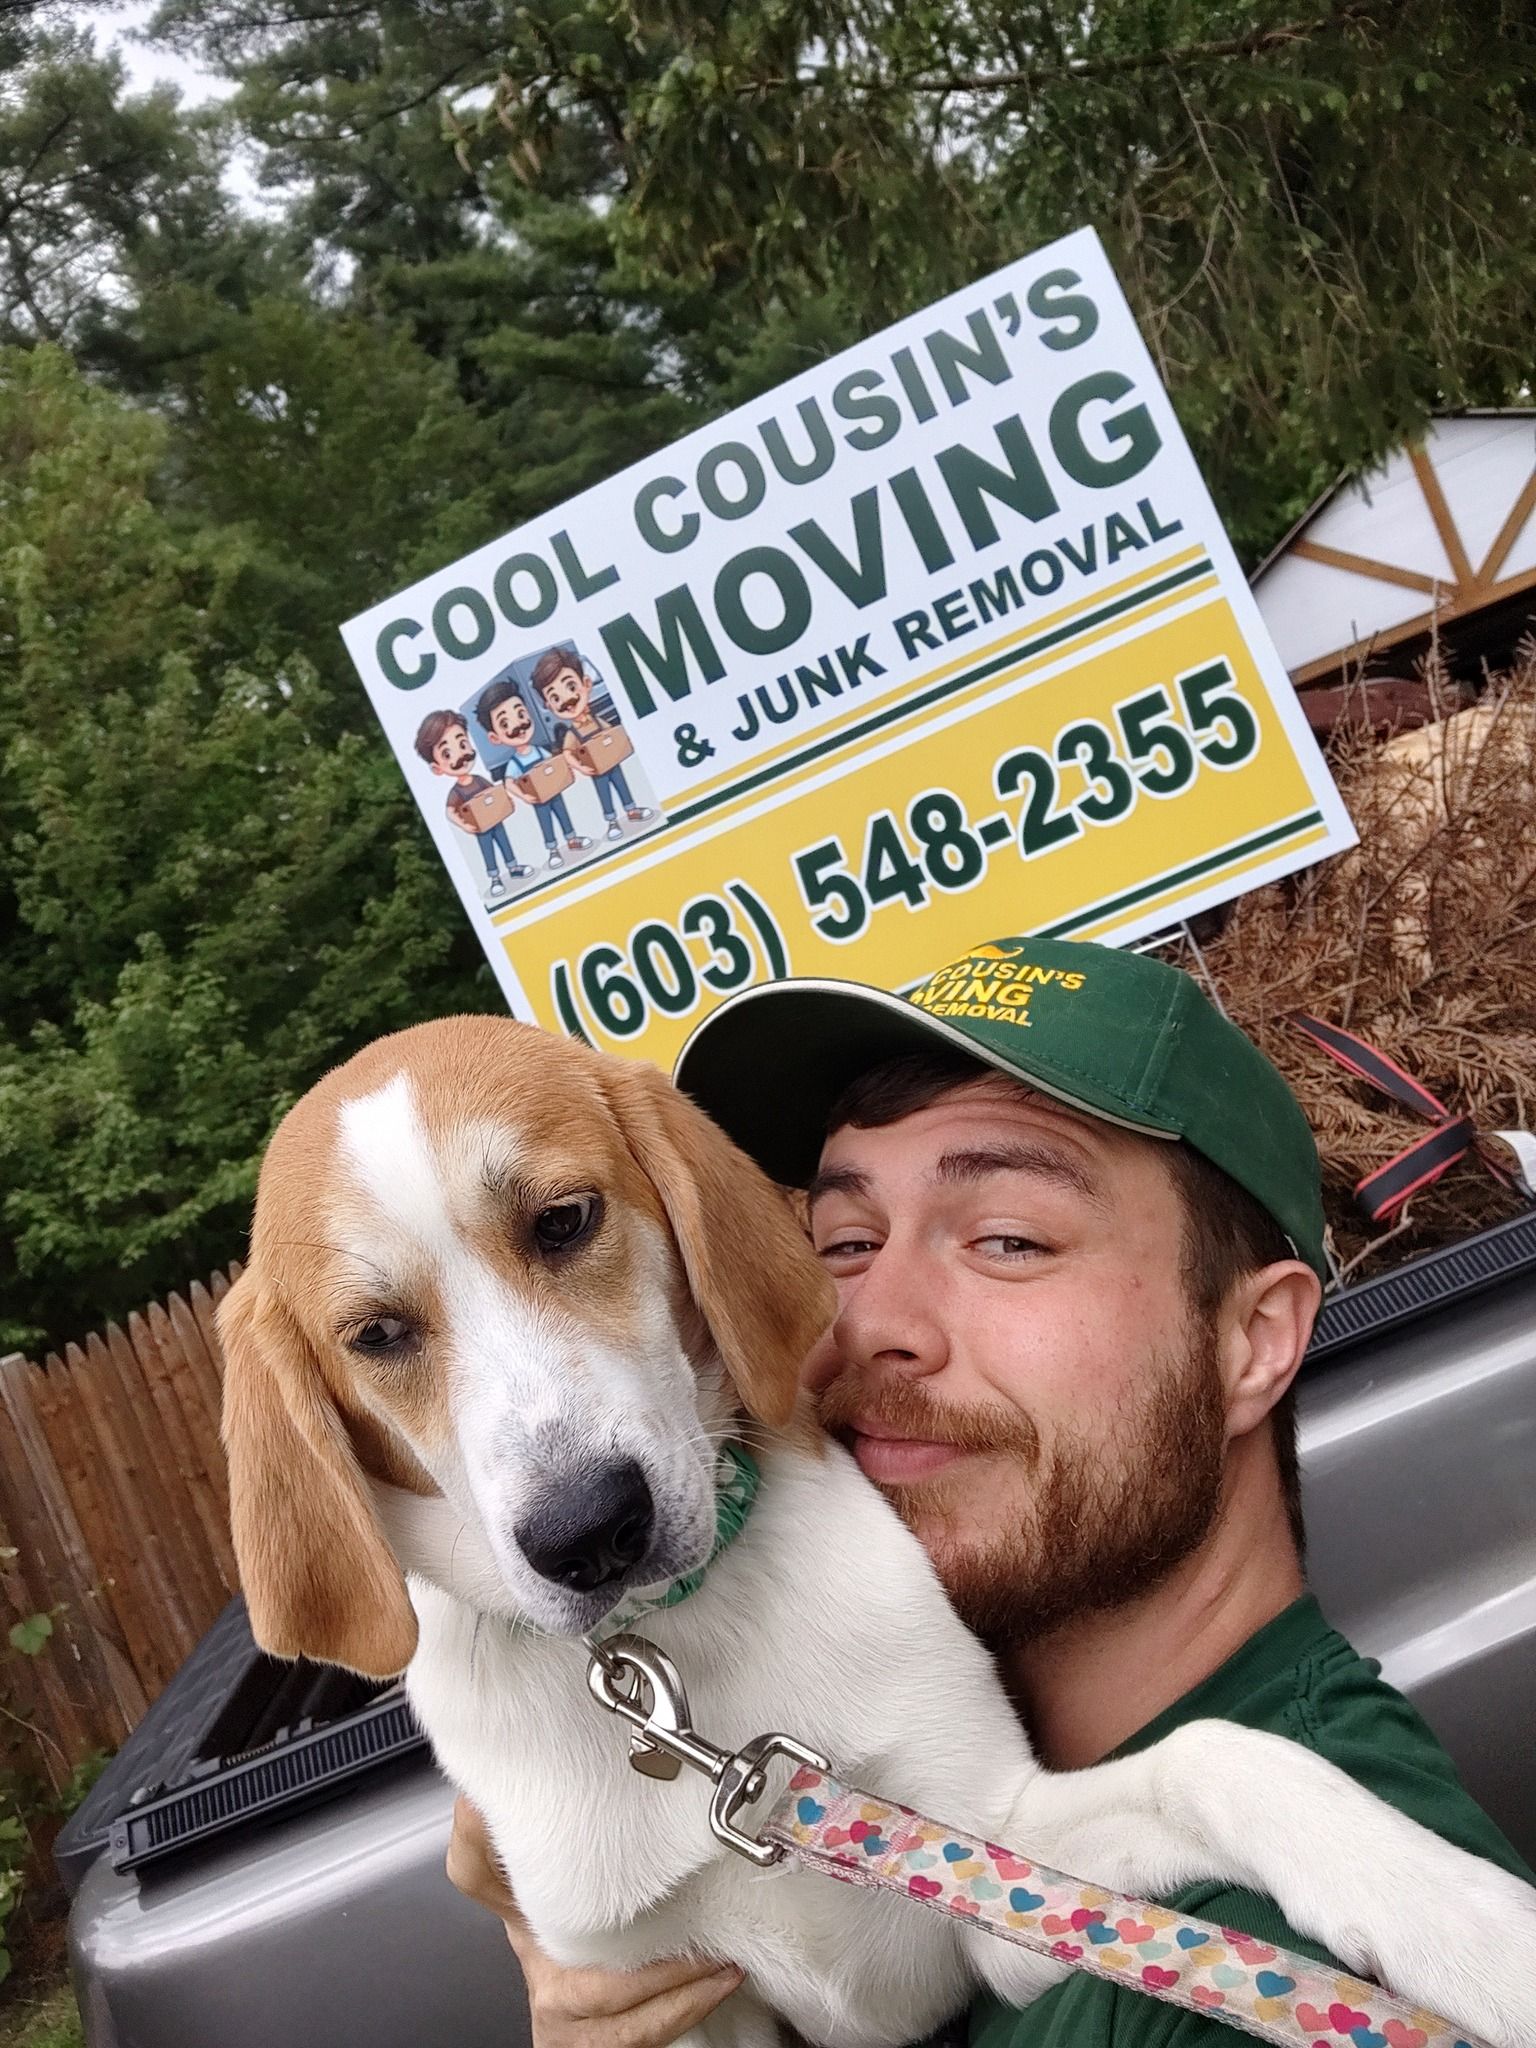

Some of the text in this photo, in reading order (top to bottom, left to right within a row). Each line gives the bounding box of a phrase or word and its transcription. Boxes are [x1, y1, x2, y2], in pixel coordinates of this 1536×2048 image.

[375, 269, 1099, 691] COOL COUSIN'S
[598, 371, 1163, 720] MOVING
[674, 498, 1183, 768] & JUNK REMOVAL
[554, 660, 1257, 1050] (603) 548-2355
[930, 960, 1087, 991] COUSIN'S
[922, 1001, 1034, 1028] EMOVAL
